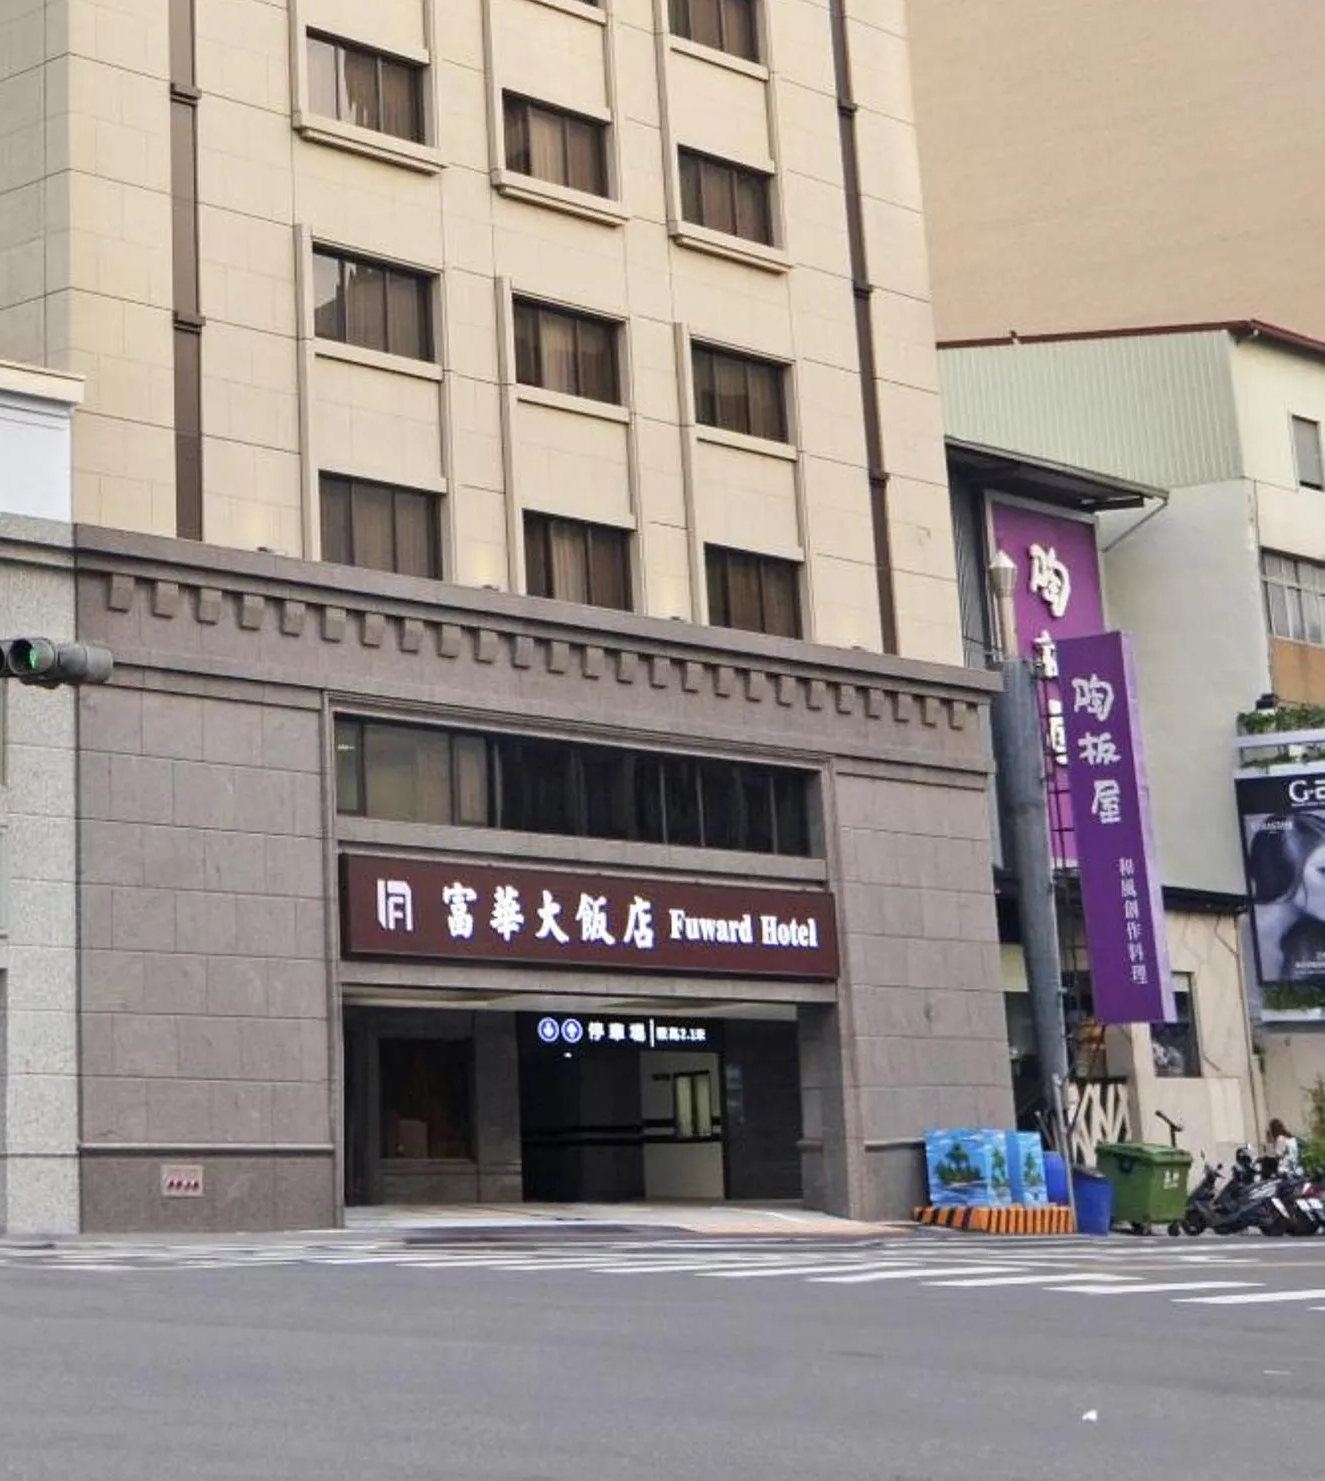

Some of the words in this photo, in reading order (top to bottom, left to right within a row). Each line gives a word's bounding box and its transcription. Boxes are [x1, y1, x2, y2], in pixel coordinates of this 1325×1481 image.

[1071, 673, 1121, 824] 陶板屋
[442, 882, 655, 949] 富華大飯店
[669, 908, 753, 945] Fuward
[760, 915, 819, 948] Hotel
